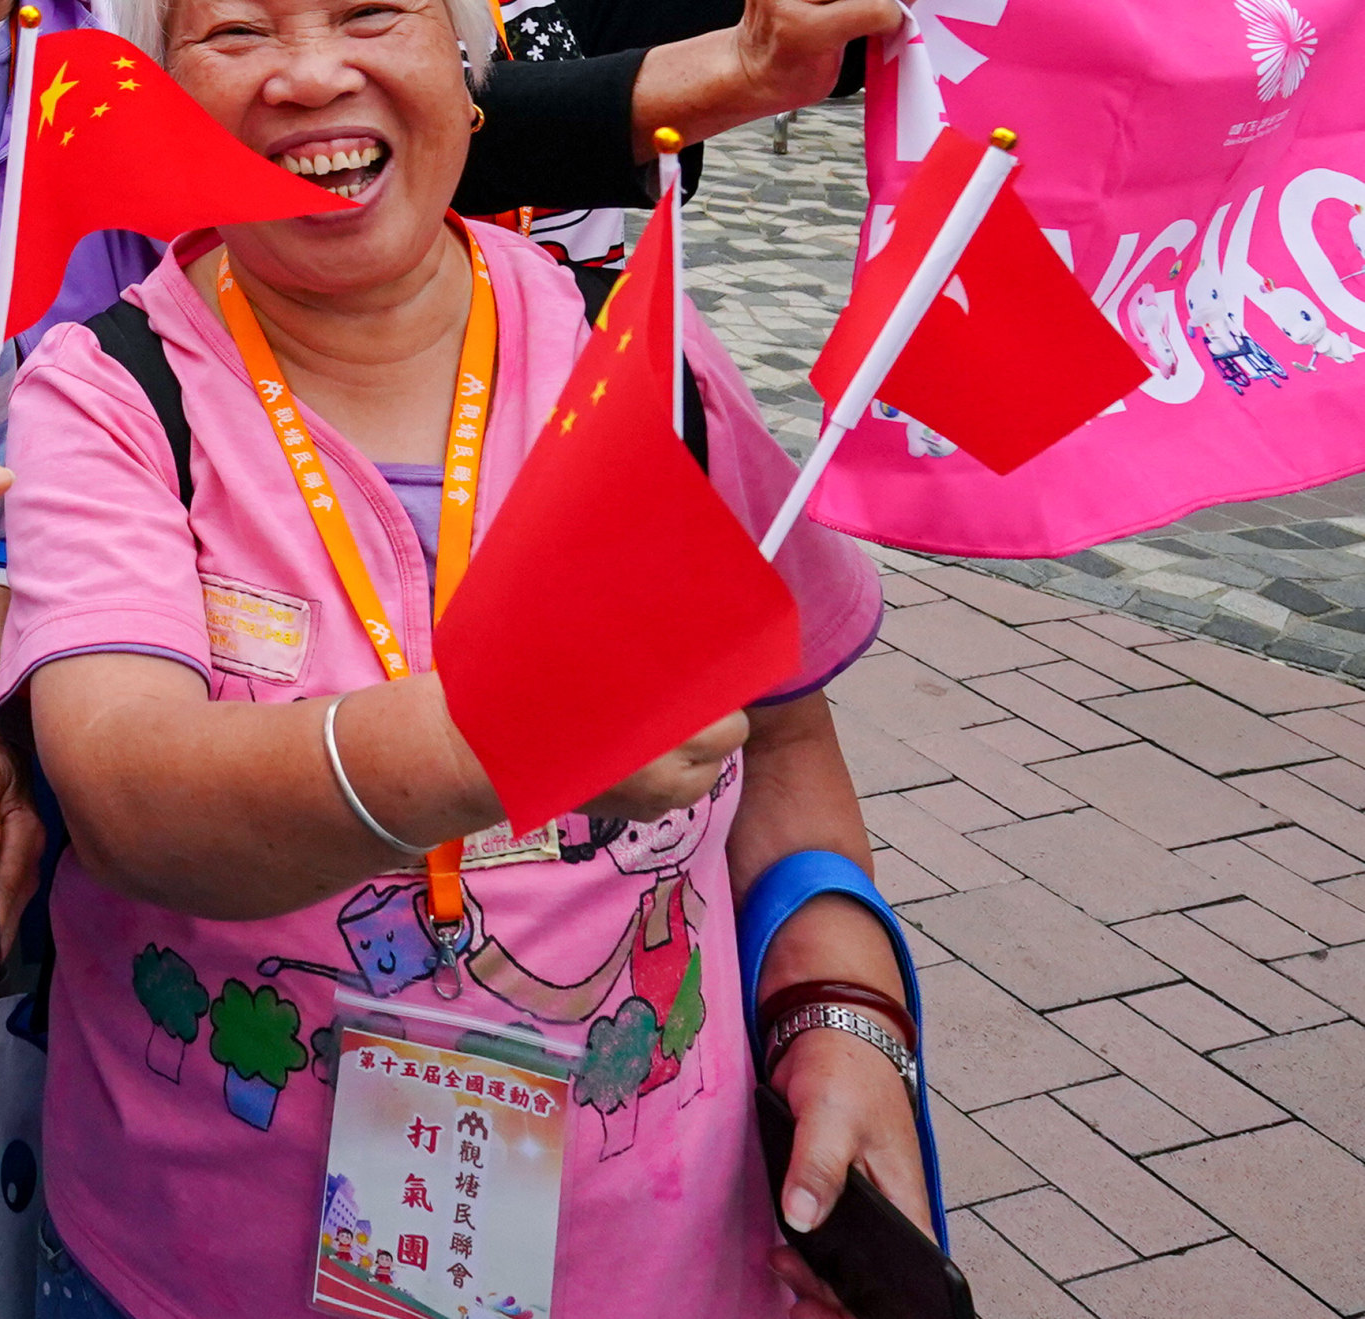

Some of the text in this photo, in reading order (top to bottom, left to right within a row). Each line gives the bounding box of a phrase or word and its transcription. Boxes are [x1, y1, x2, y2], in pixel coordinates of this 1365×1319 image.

[358, 1048, 555, 1116] 第十五屆全國運動會
[397, 1116, 443, 1272] 打氣團
[447, 1139, 484, 1289] 觀塘民聯會
